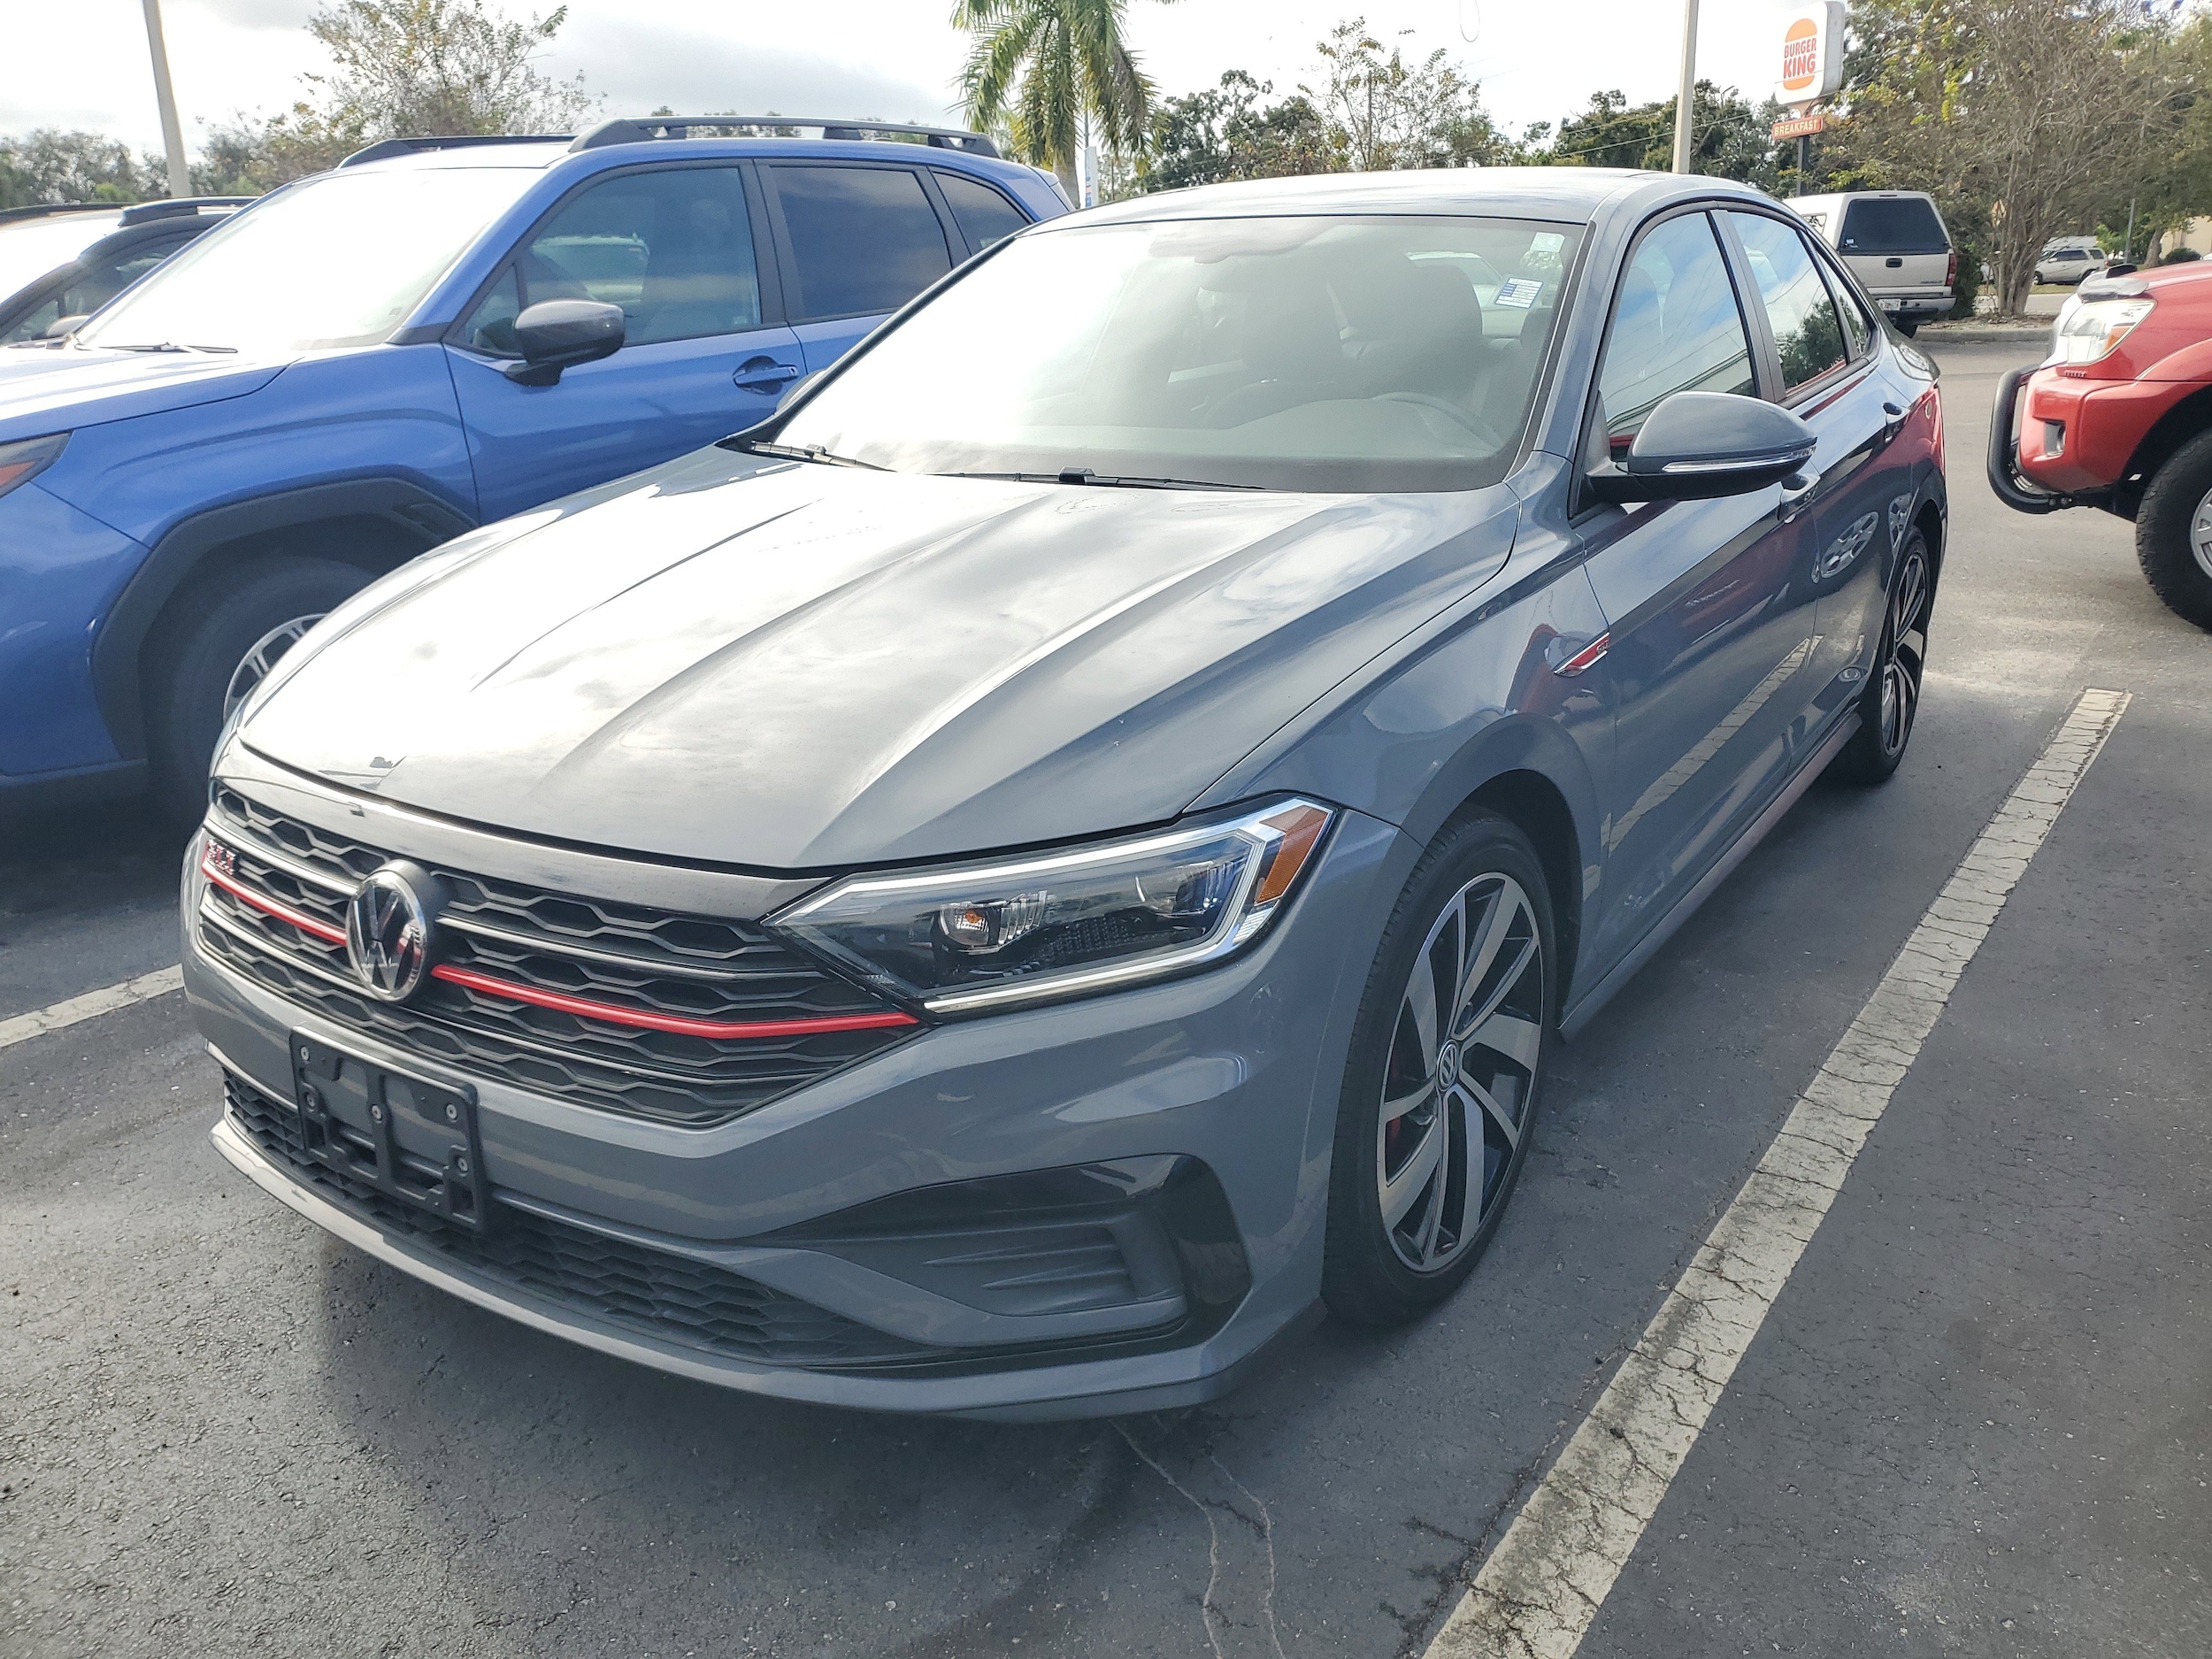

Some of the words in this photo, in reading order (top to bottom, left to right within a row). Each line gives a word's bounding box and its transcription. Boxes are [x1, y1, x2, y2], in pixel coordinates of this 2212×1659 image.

[1784, 38, 1817, 59] BURGER
[1783, 53, 1816, 80] KING
[1774, 119, 1818, 136] BREAKFAST
